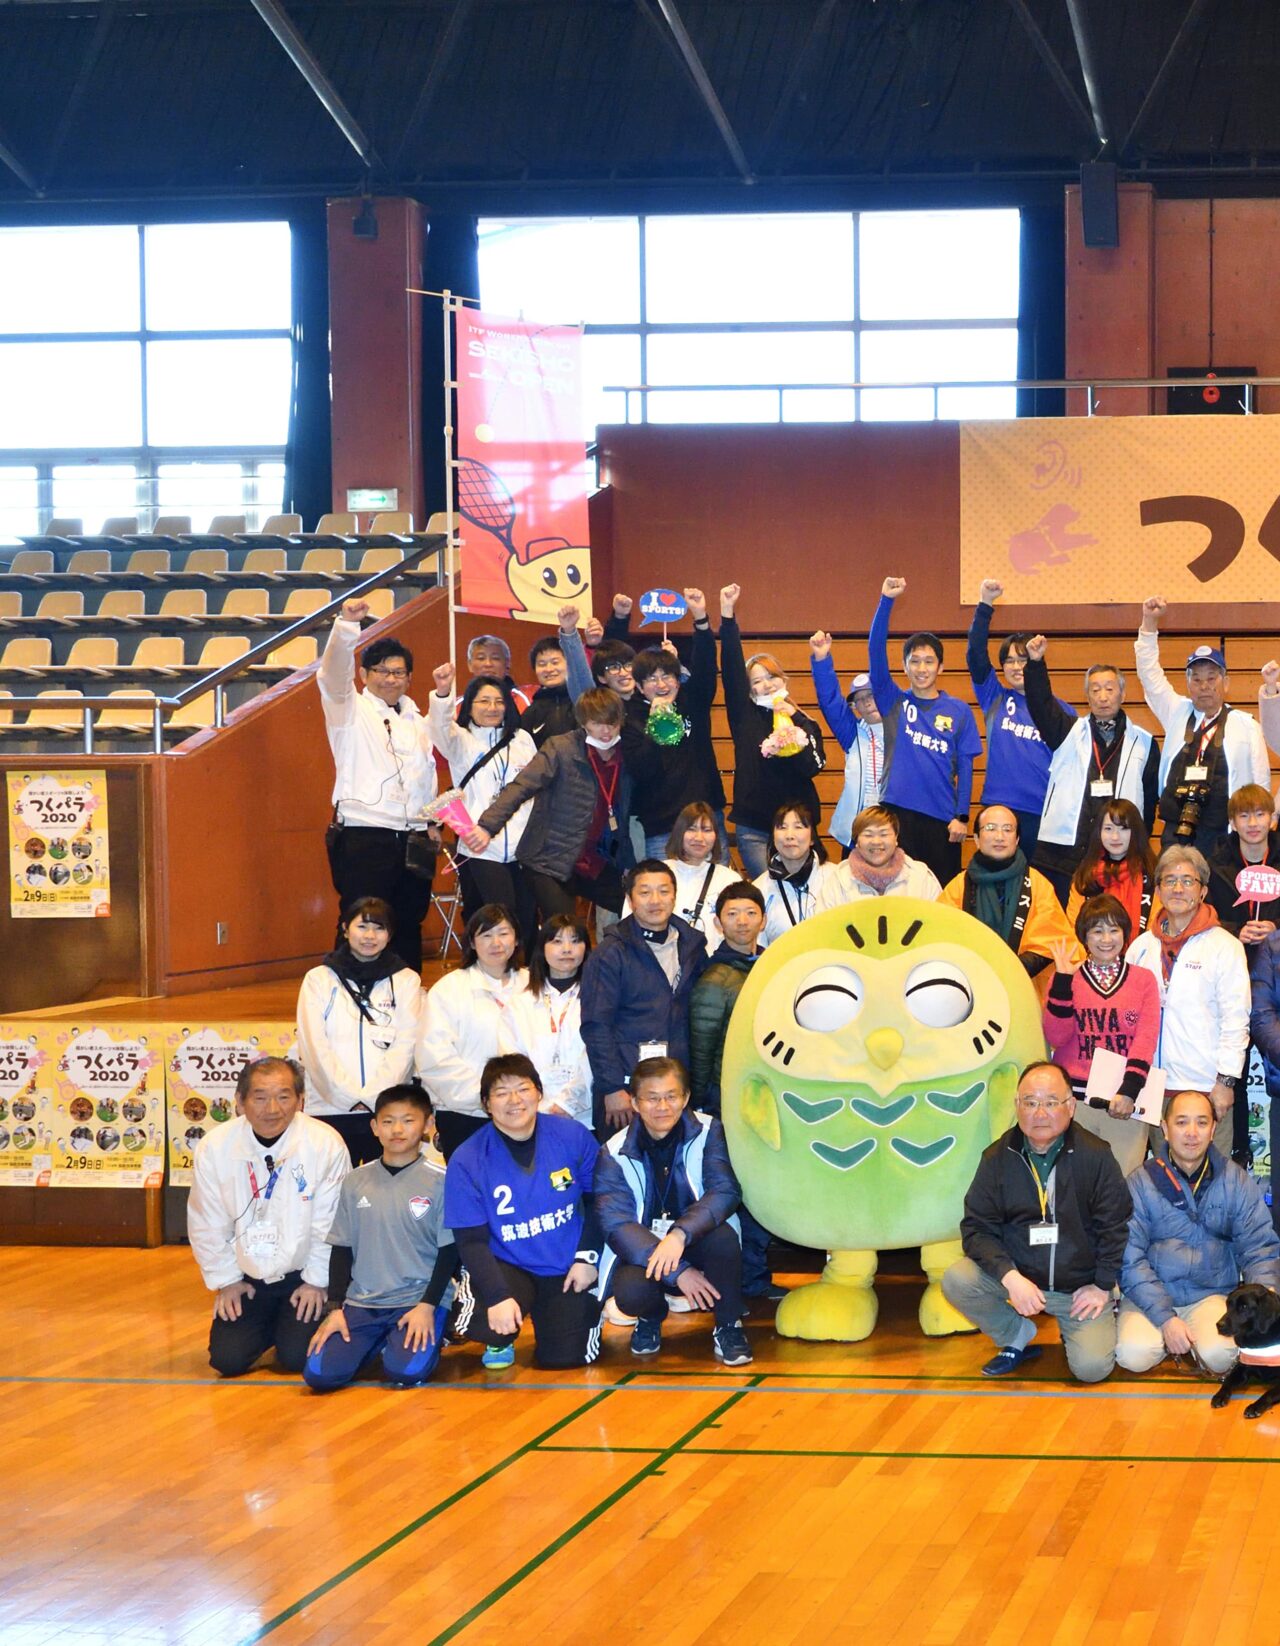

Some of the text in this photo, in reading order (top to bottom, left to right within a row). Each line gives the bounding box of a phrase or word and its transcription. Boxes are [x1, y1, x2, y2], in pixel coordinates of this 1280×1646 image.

[641, 604, 685, 616] SPORTS!
[902, 699, 918, 723] 10
[30, 797, 85, 812] つくパラ
[41, 813, 77, 823] 2020
[1239, 878, 1280, 896] FAN!
[1073, 1007, 1121, 1033] VIVA
[1078, 1033, 1135, 1060] HEAR
[77, 1053, 139, 1070] つくパラ
[188, 1053, 250, 1069] つくパラ
[89, 1071, 129, 1081] 2020
[493, 1185, 515, 1215] 2
